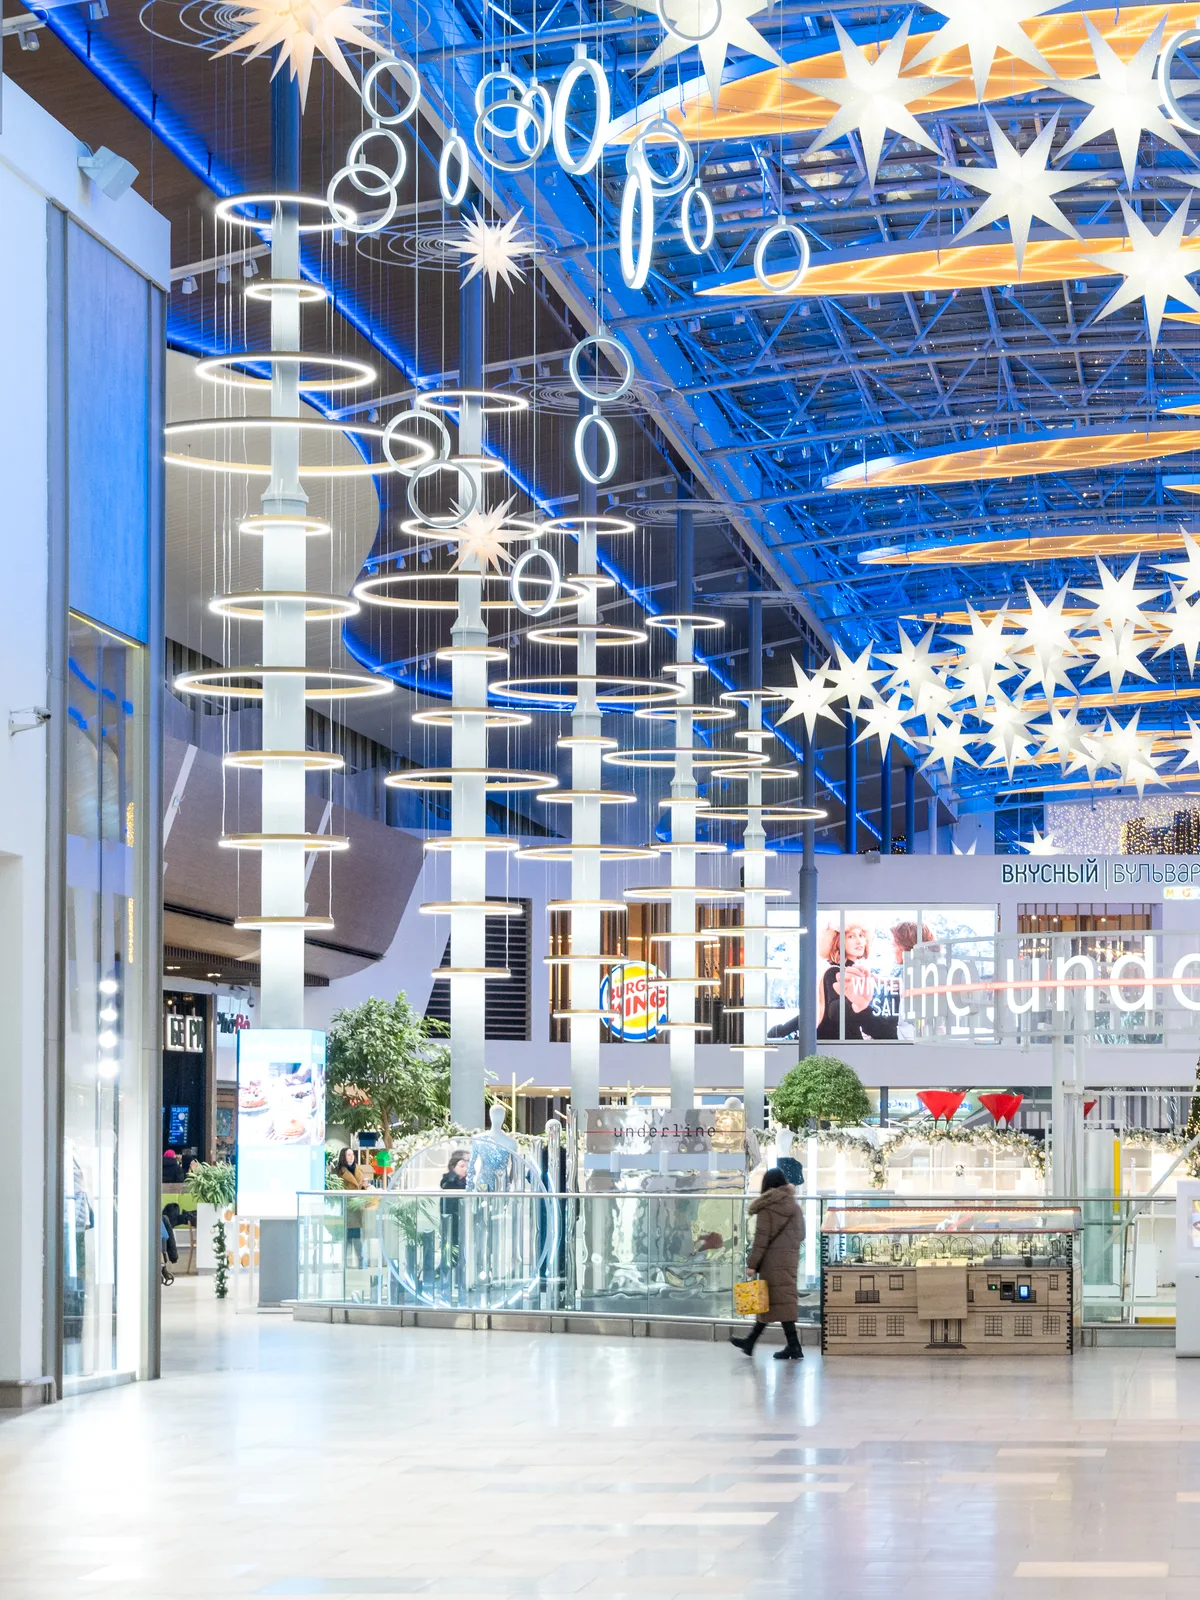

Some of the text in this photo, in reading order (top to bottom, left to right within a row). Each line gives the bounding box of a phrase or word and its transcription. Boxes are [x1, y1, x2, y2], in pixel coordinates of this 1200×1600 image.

[1002, 858, 1099, 883] ВКУСНЫЙ
[852, 977, 900, 995] WINTE
[872, 998, 900, 1016] SAL
[613, 1123, 716, 1138] underline
